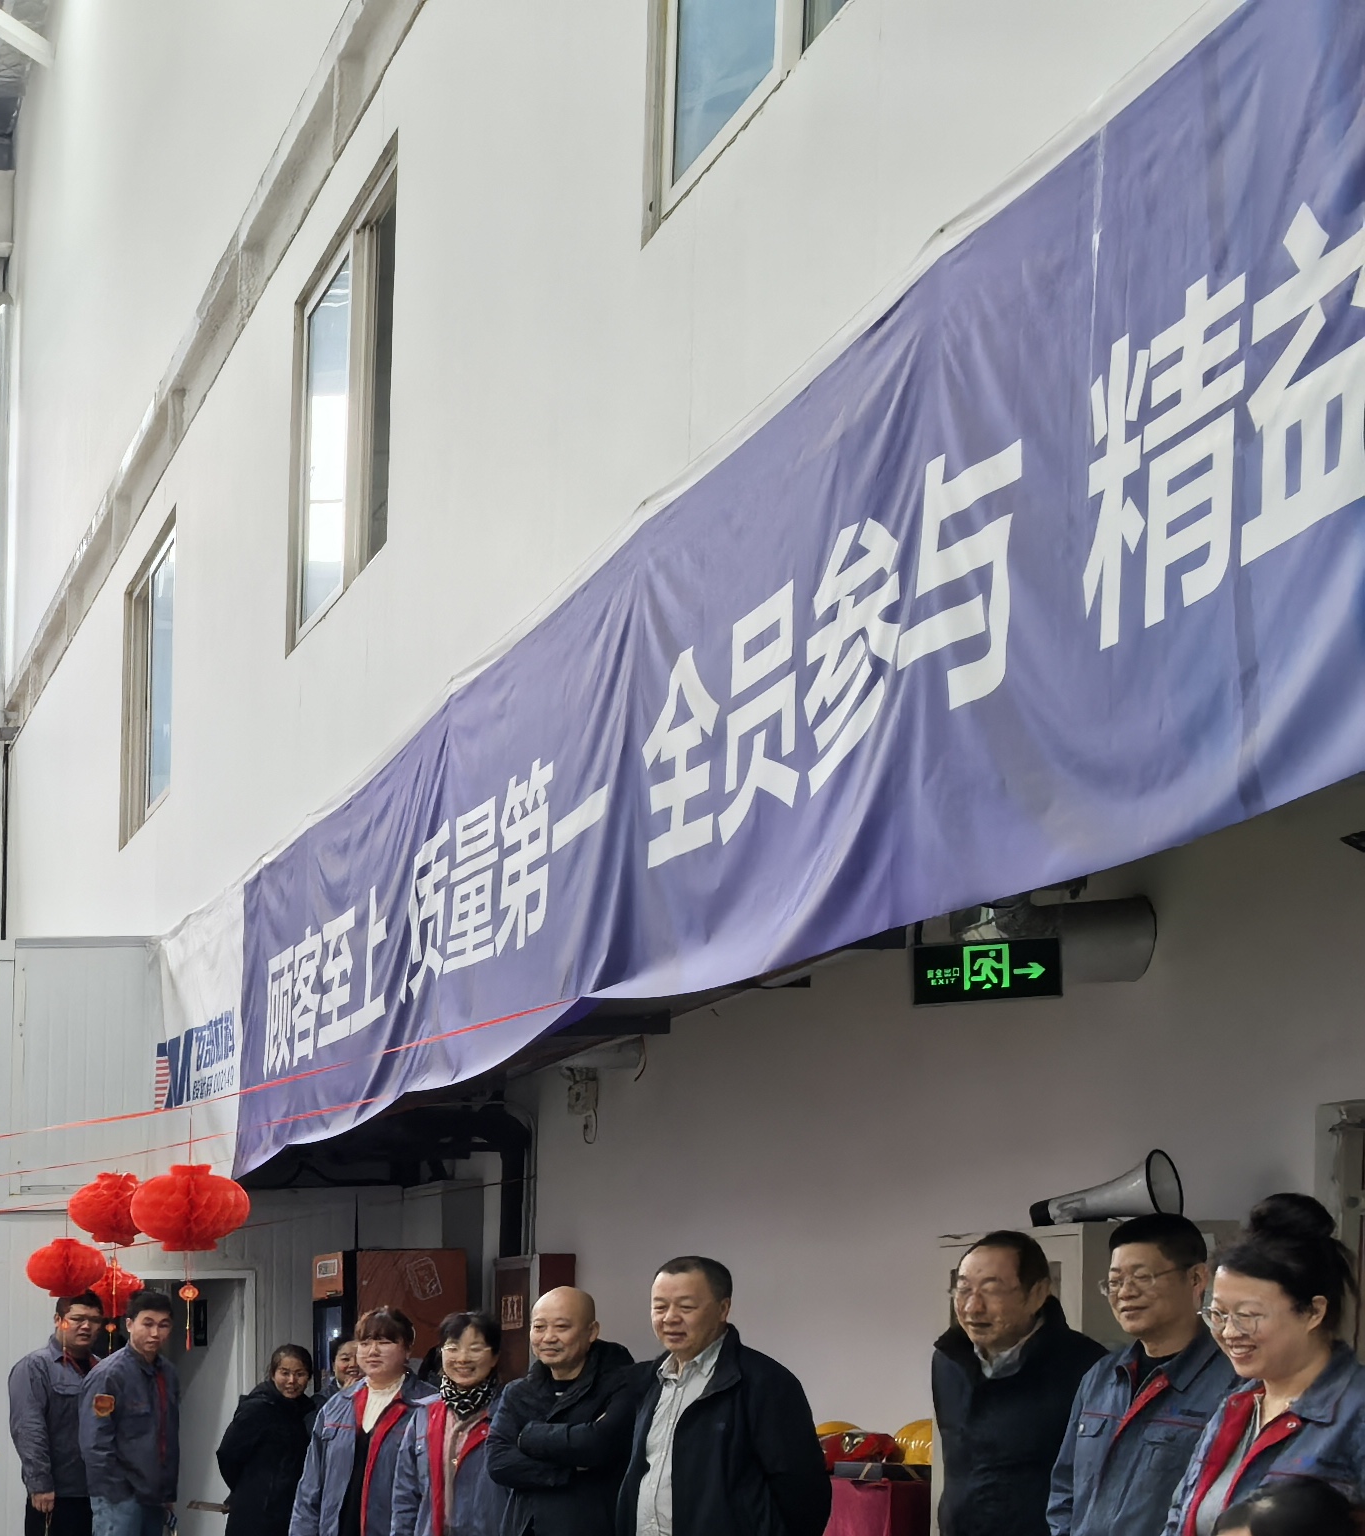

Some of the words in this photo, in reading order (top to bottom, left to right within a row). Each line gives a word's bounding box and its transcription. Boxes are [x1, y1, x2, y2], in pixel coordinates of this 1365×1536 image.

[263, 885, 388, 1080] 顾客至上
[400, 758, 610, 1004] 质量第一
[644, 438, 1023, 870] 全员参与
[1083, 201, 1365, 651] 精益
[926, 967, 960, 979] 安全出口
[930, 977, 956, 986] EXIT
